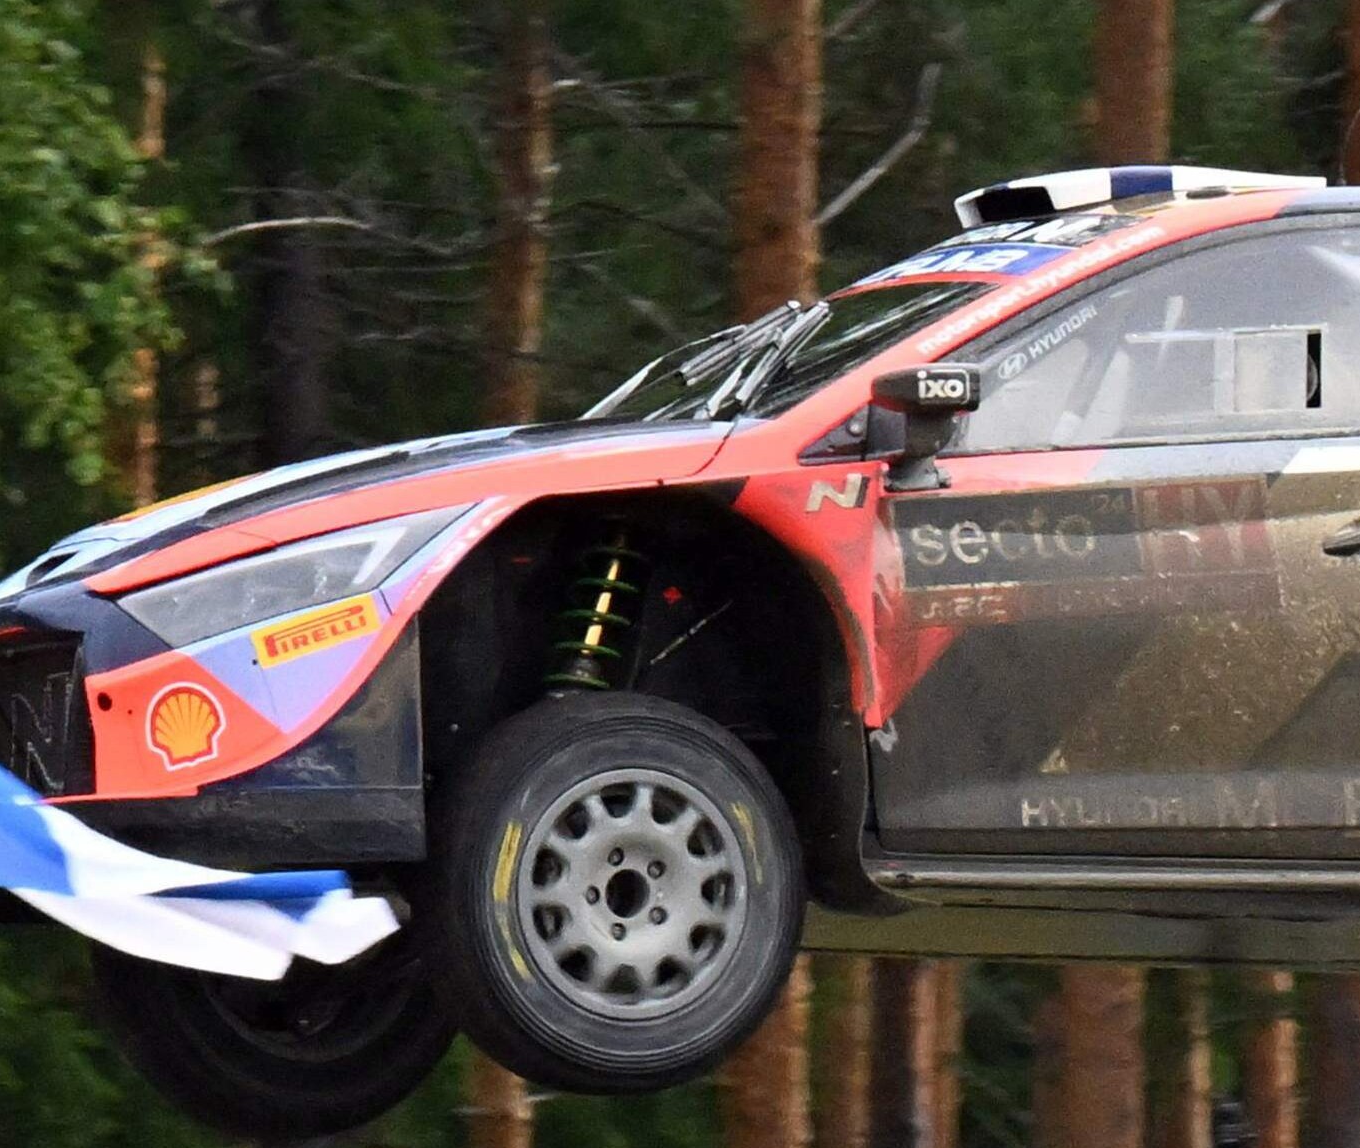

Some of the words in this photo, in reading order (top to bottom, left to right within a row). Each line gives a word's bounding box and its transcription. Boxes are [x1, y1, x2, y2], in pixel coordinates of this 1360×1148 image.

[1028, 304, 1098, 359] HYUNDAI
[917, 370, 965, 399] ixo
[910, 505, 1096, 567] secto
[262, 604, 368, 658] PIRELLI
